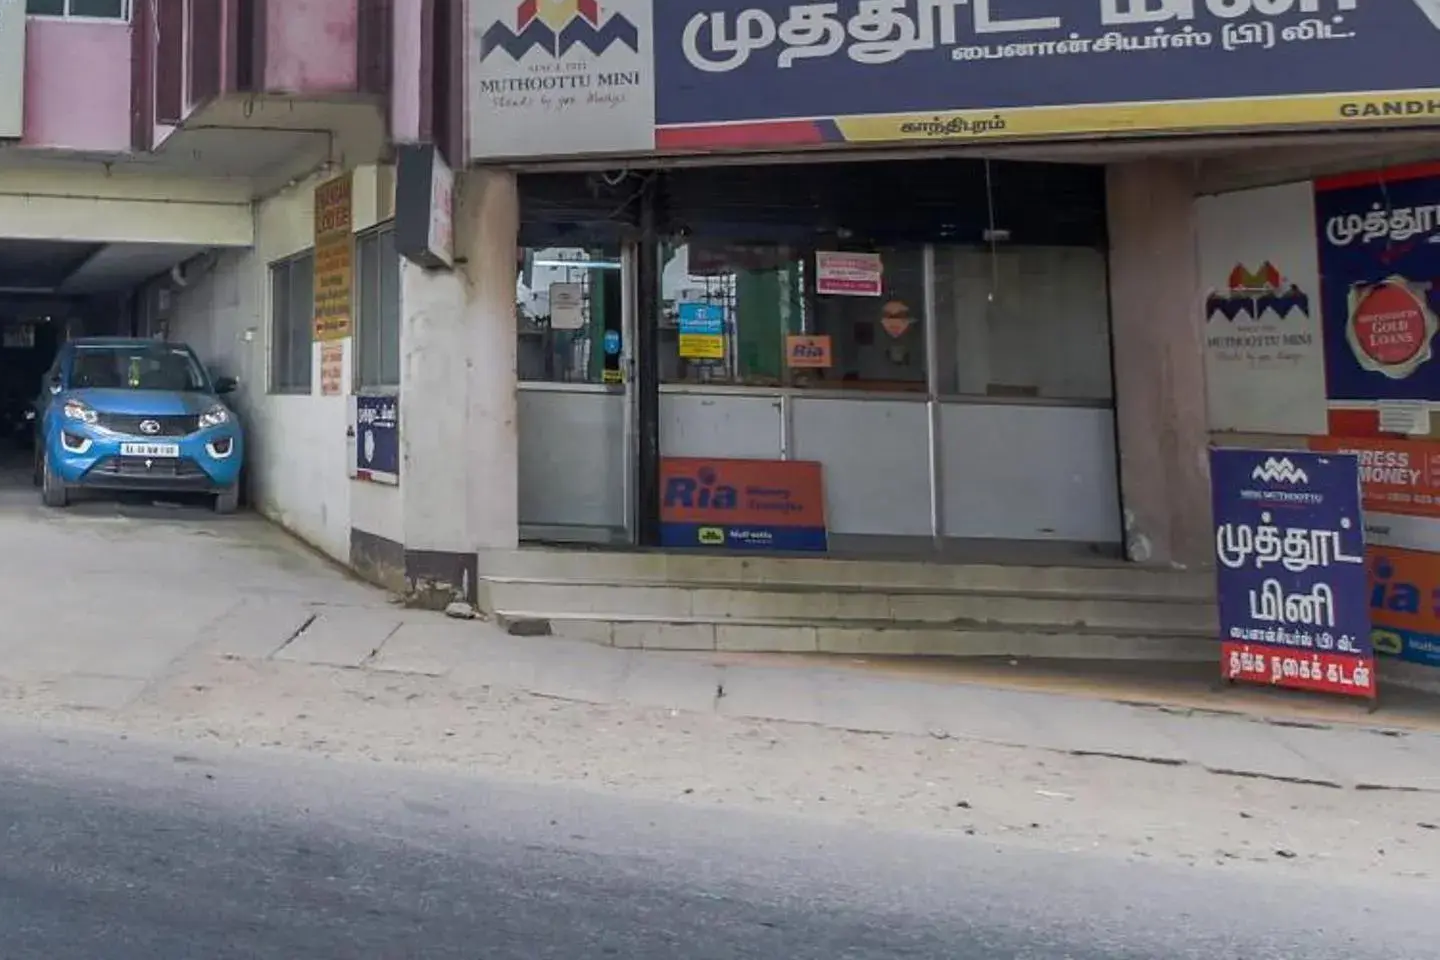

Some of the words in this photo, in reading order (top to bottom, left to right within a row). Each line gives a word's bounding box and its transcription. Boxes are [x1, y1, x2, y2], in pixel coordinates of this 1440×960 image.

[480, 75, 590, 92] MUTHOOTTU
[598, 71, 639, 86] MINI
[1370, 332, 1413, 346] LOANS
[1371, 320, 1408, 333] GOLD
[664, 466, 737, 509] Ria
[1217, 511, 1363, 572] முத்தூட்
[1249, 578, 1335, 627] மினி
[1230, 646, 1266, 678] தங்க
